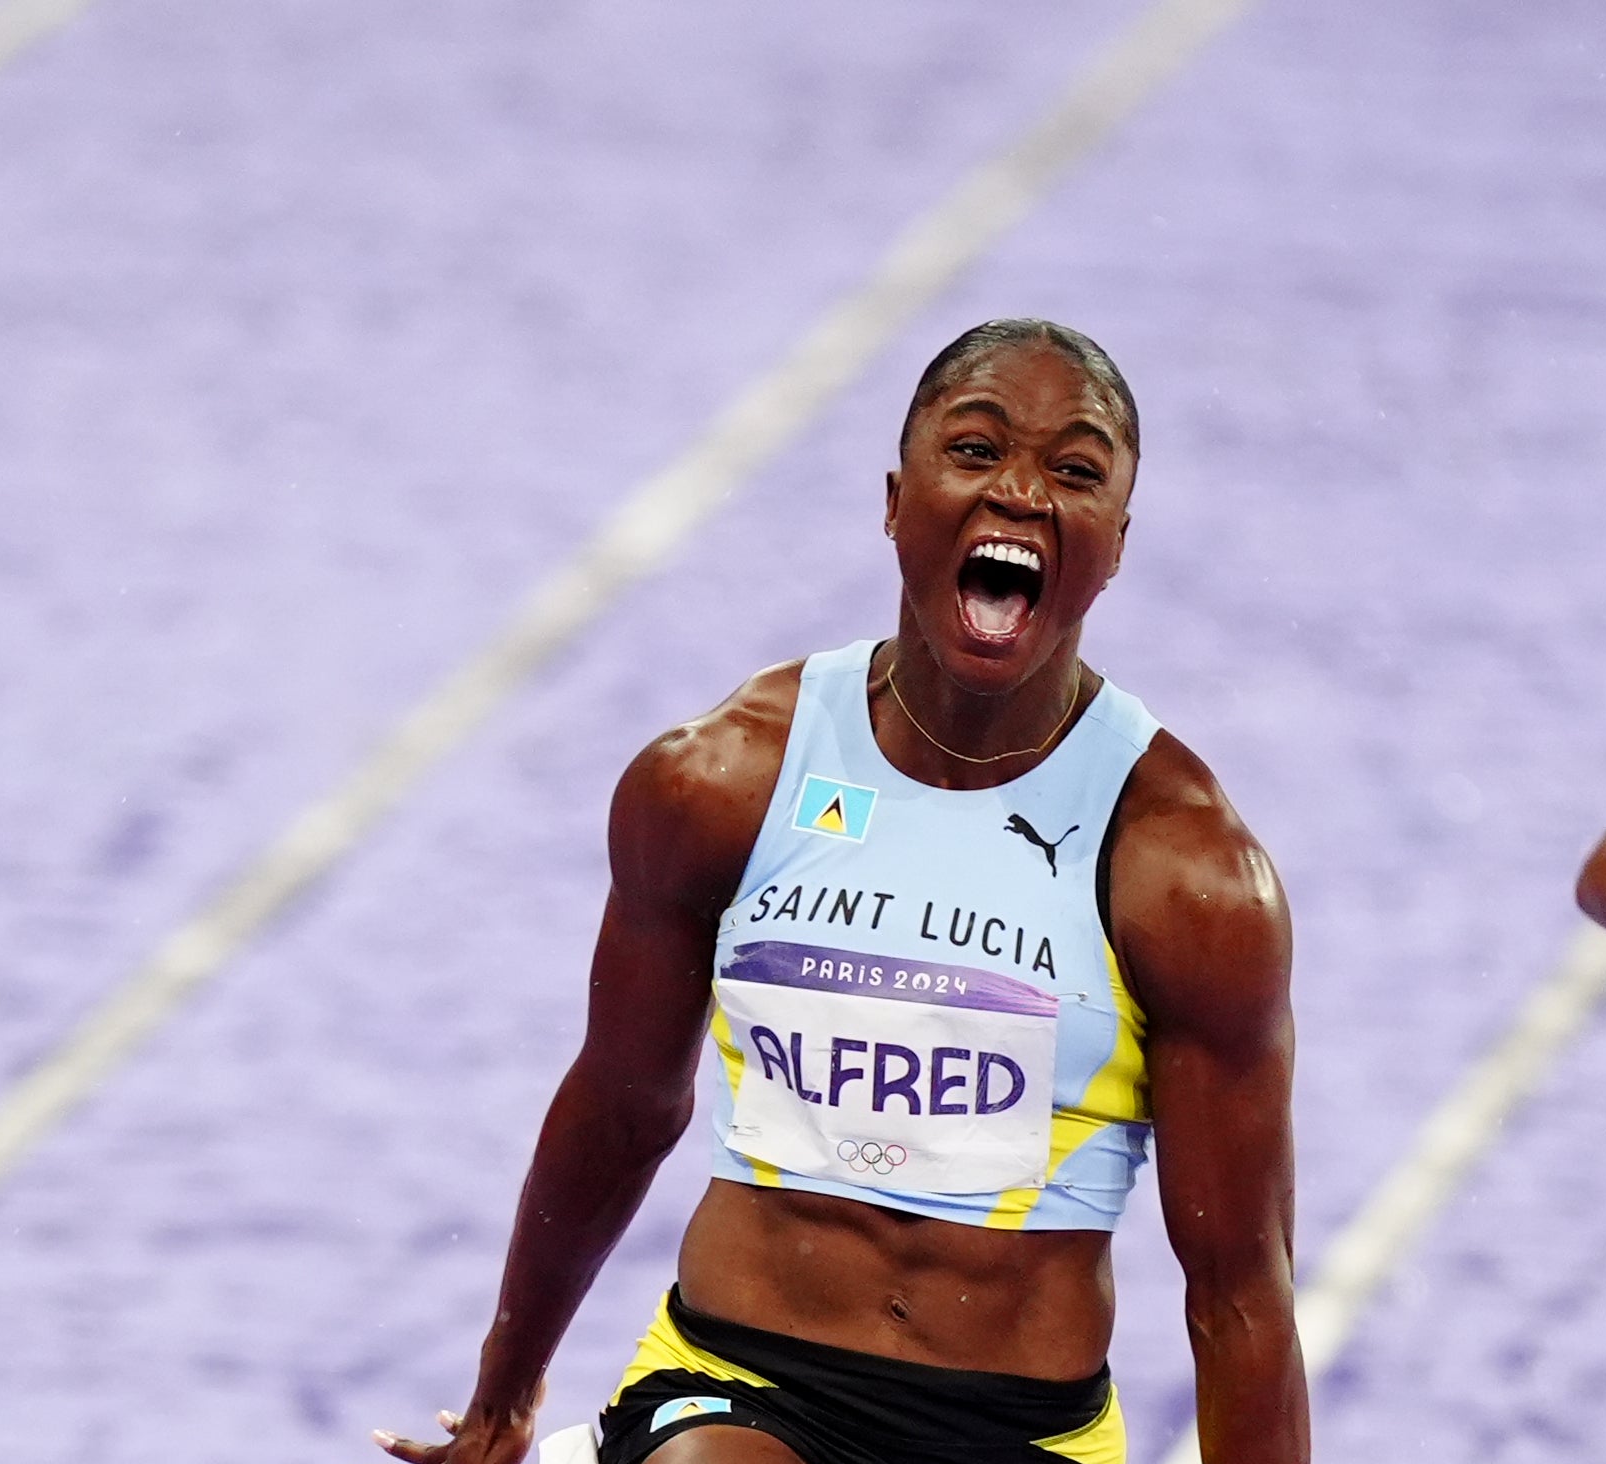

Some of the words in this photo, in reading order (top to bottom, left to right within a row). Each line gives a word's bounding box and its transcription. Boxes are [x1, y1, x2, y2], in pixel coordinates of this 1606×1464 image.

[749, 884, 895, 930] SAINT
[919, 901, 1057, 980] LUCIA
[800, 956, 883, 986] PARIS
[893, 969, 968, 996] 2024
[749, 1024, 1027, 1117] ALFRED
